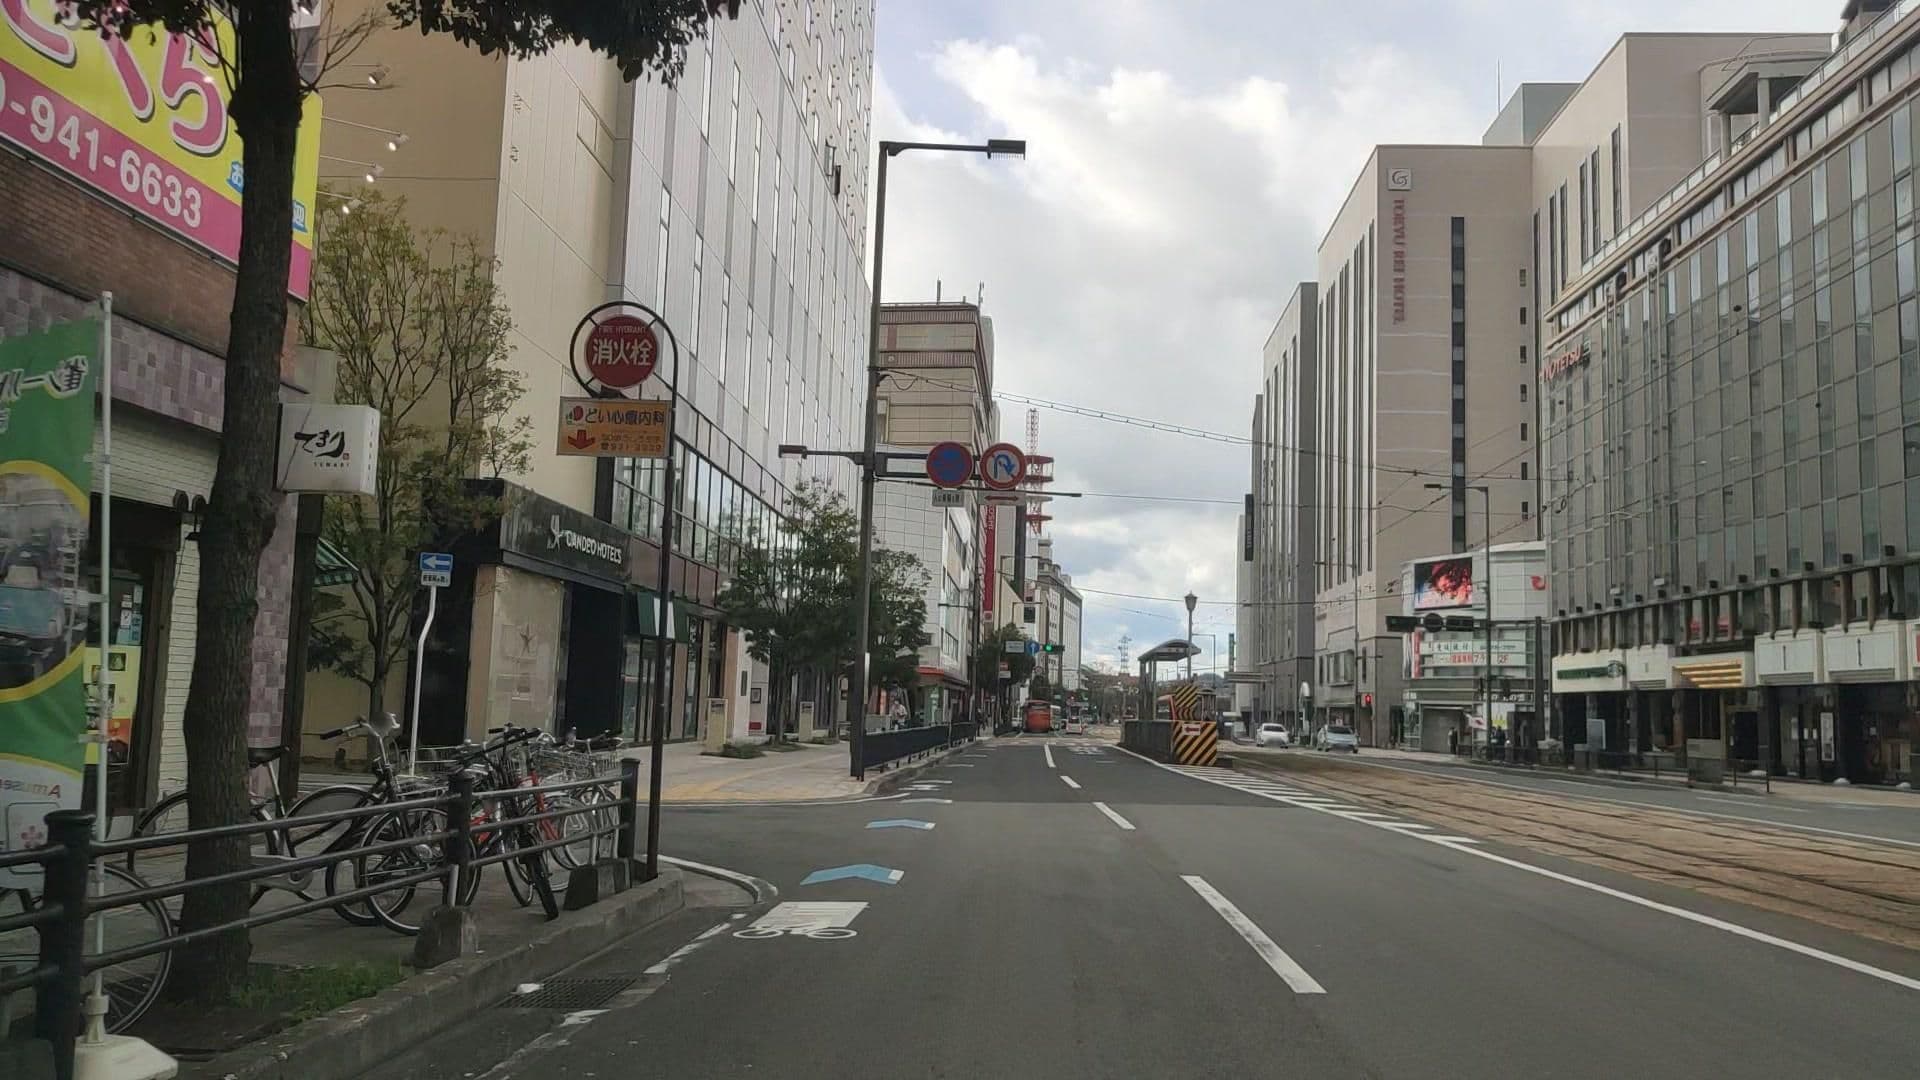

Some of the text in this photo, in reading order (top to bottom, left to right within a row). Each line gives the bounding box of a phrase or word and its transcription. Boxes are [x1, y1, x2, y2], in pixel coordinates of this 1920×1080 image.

[0, 70, 203, 230] -941-6633
[592, 338, 653, 366] 消火栓
[565, 530, 622, 564] CANDEO HOTELS
